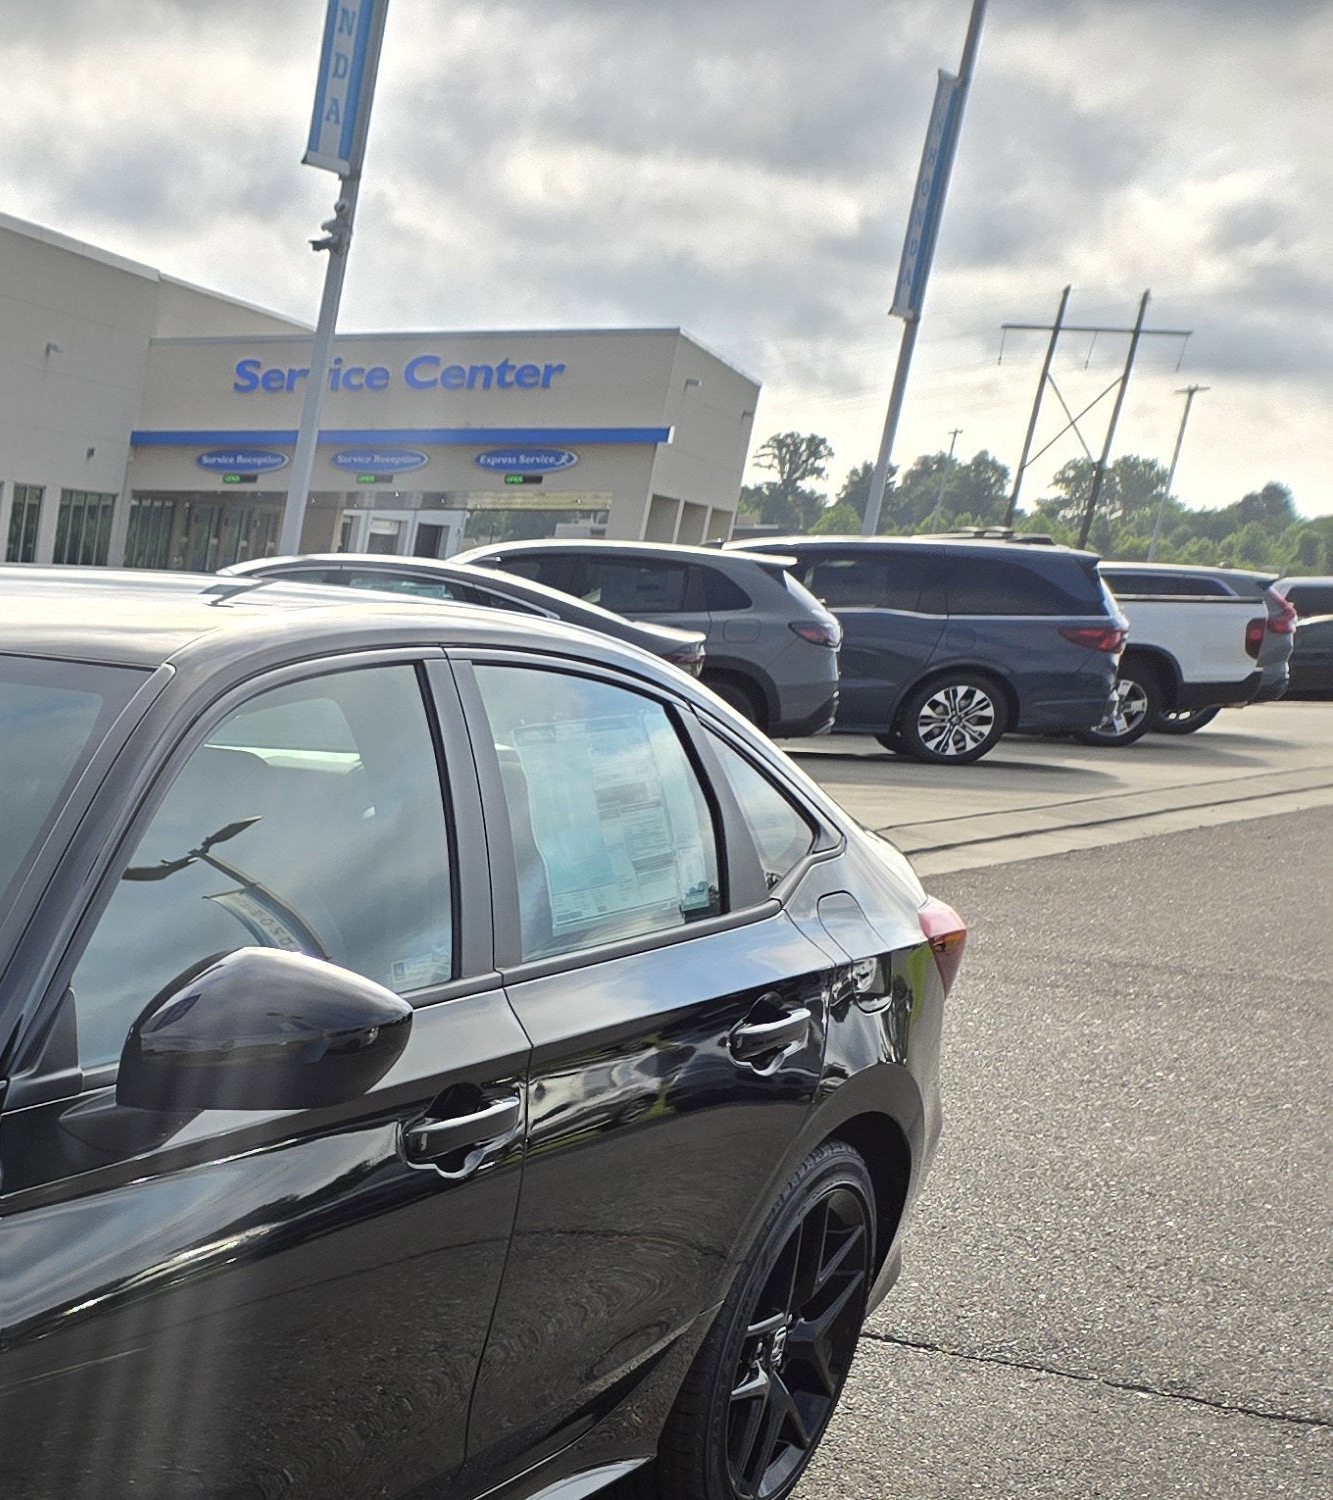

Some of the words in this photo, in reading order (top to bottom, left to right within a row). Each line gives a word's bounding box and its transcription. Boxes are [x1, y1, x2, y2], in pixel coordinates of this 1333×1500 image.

[233, 356, 391, 394] Serice
[404, 354, 567, 391] Center
[479, 454, 517, 467] Express
[518, 454, 556, 465] Service
